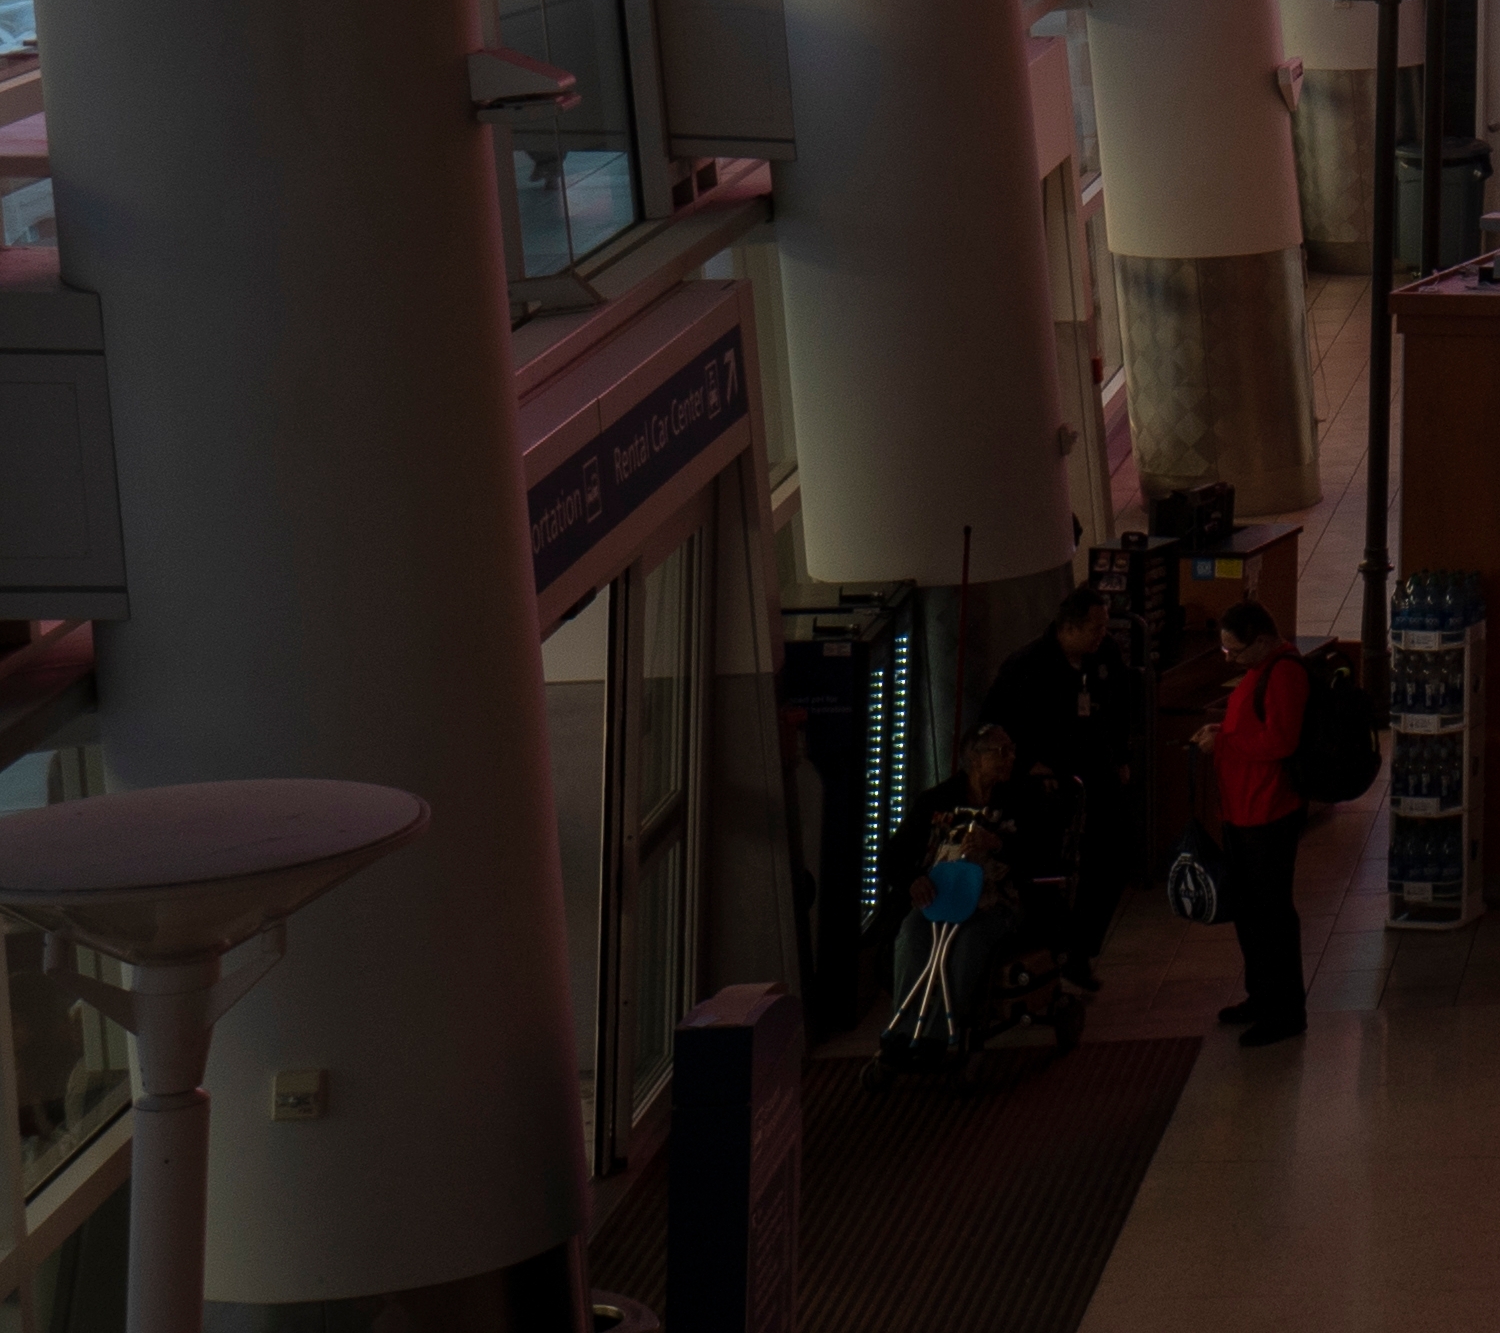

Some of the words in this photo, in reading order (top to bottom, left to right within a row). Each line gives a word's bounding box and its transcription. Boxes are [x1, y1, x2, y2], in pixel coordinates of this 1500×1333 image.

[614, 421, 649, 486] Rental
[652, 414, 669, 452] Car
[671, 387, 704, 436] Center
[533, 488, 583, 555] ortation
